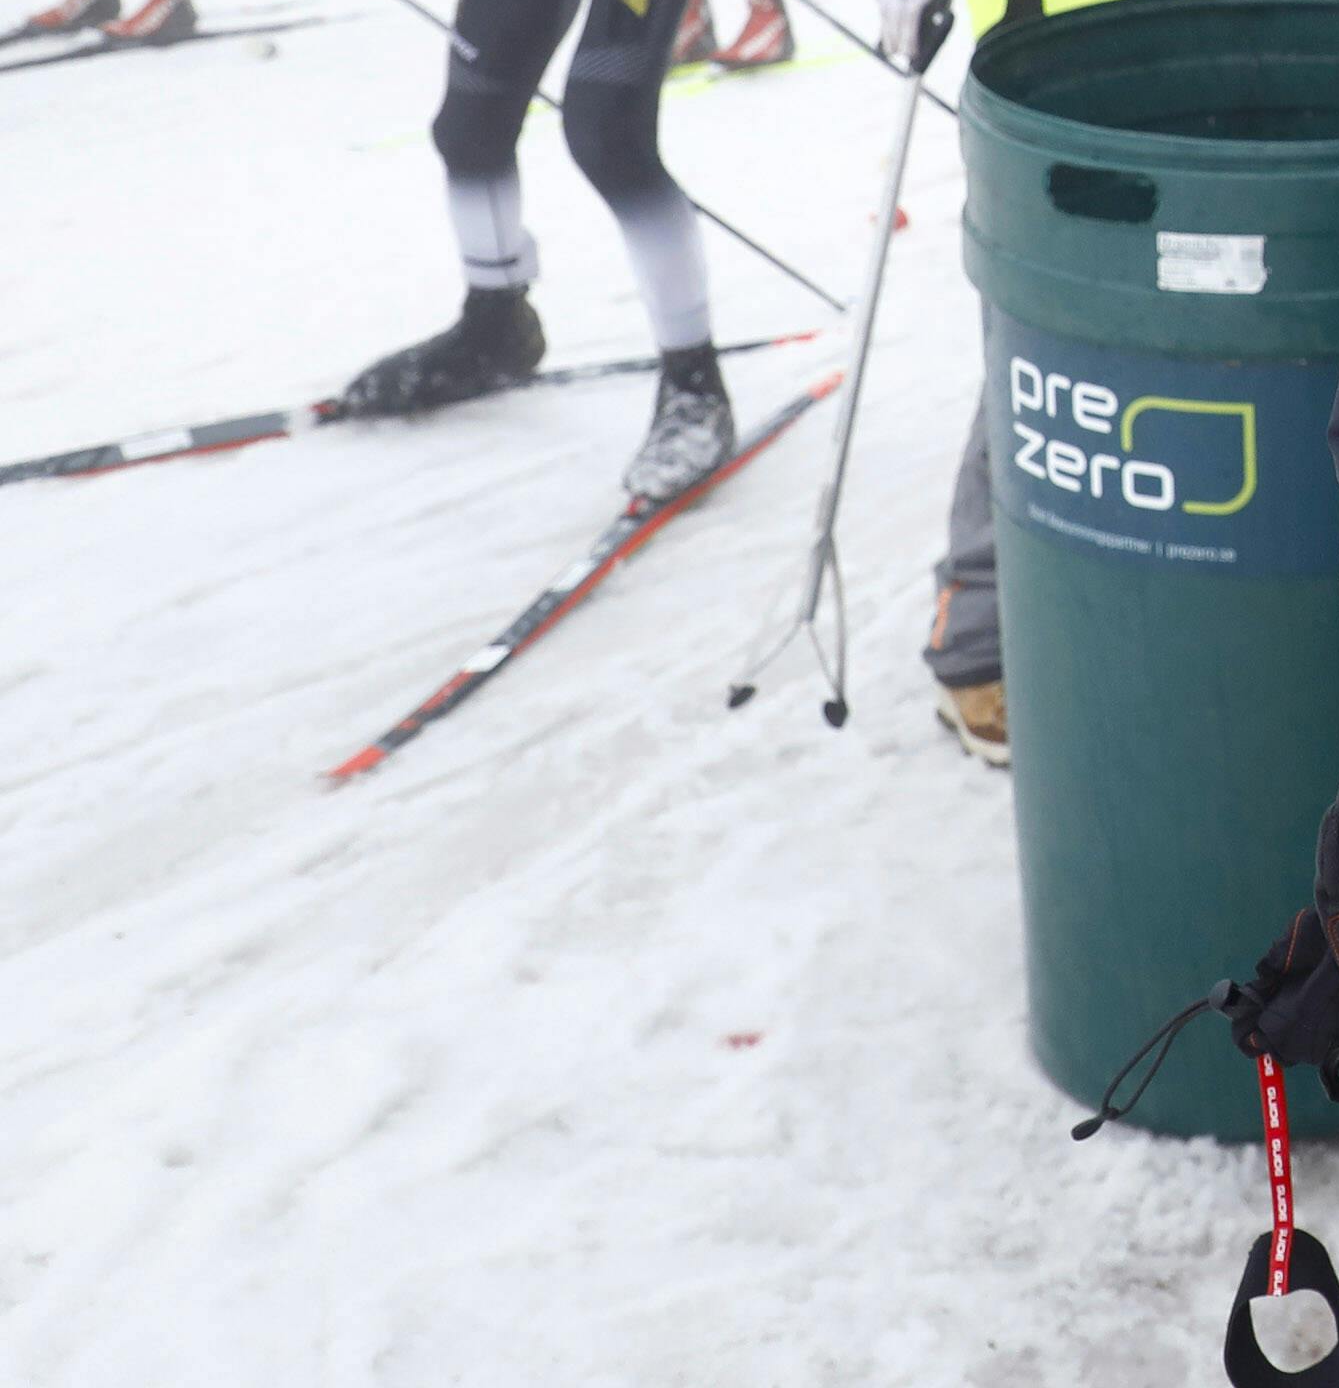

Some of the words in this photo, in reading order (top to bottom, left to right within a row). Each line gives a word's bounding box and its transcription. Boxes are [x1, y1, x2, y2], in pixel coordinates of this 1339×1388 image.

[1010, 356, 1118, 434] pre
[1012, 421, 1175, 510] zero
[1267, 1086, 1279, 1128] GUIDE
[1272, 1138, 1284, 1177] GUIDE
